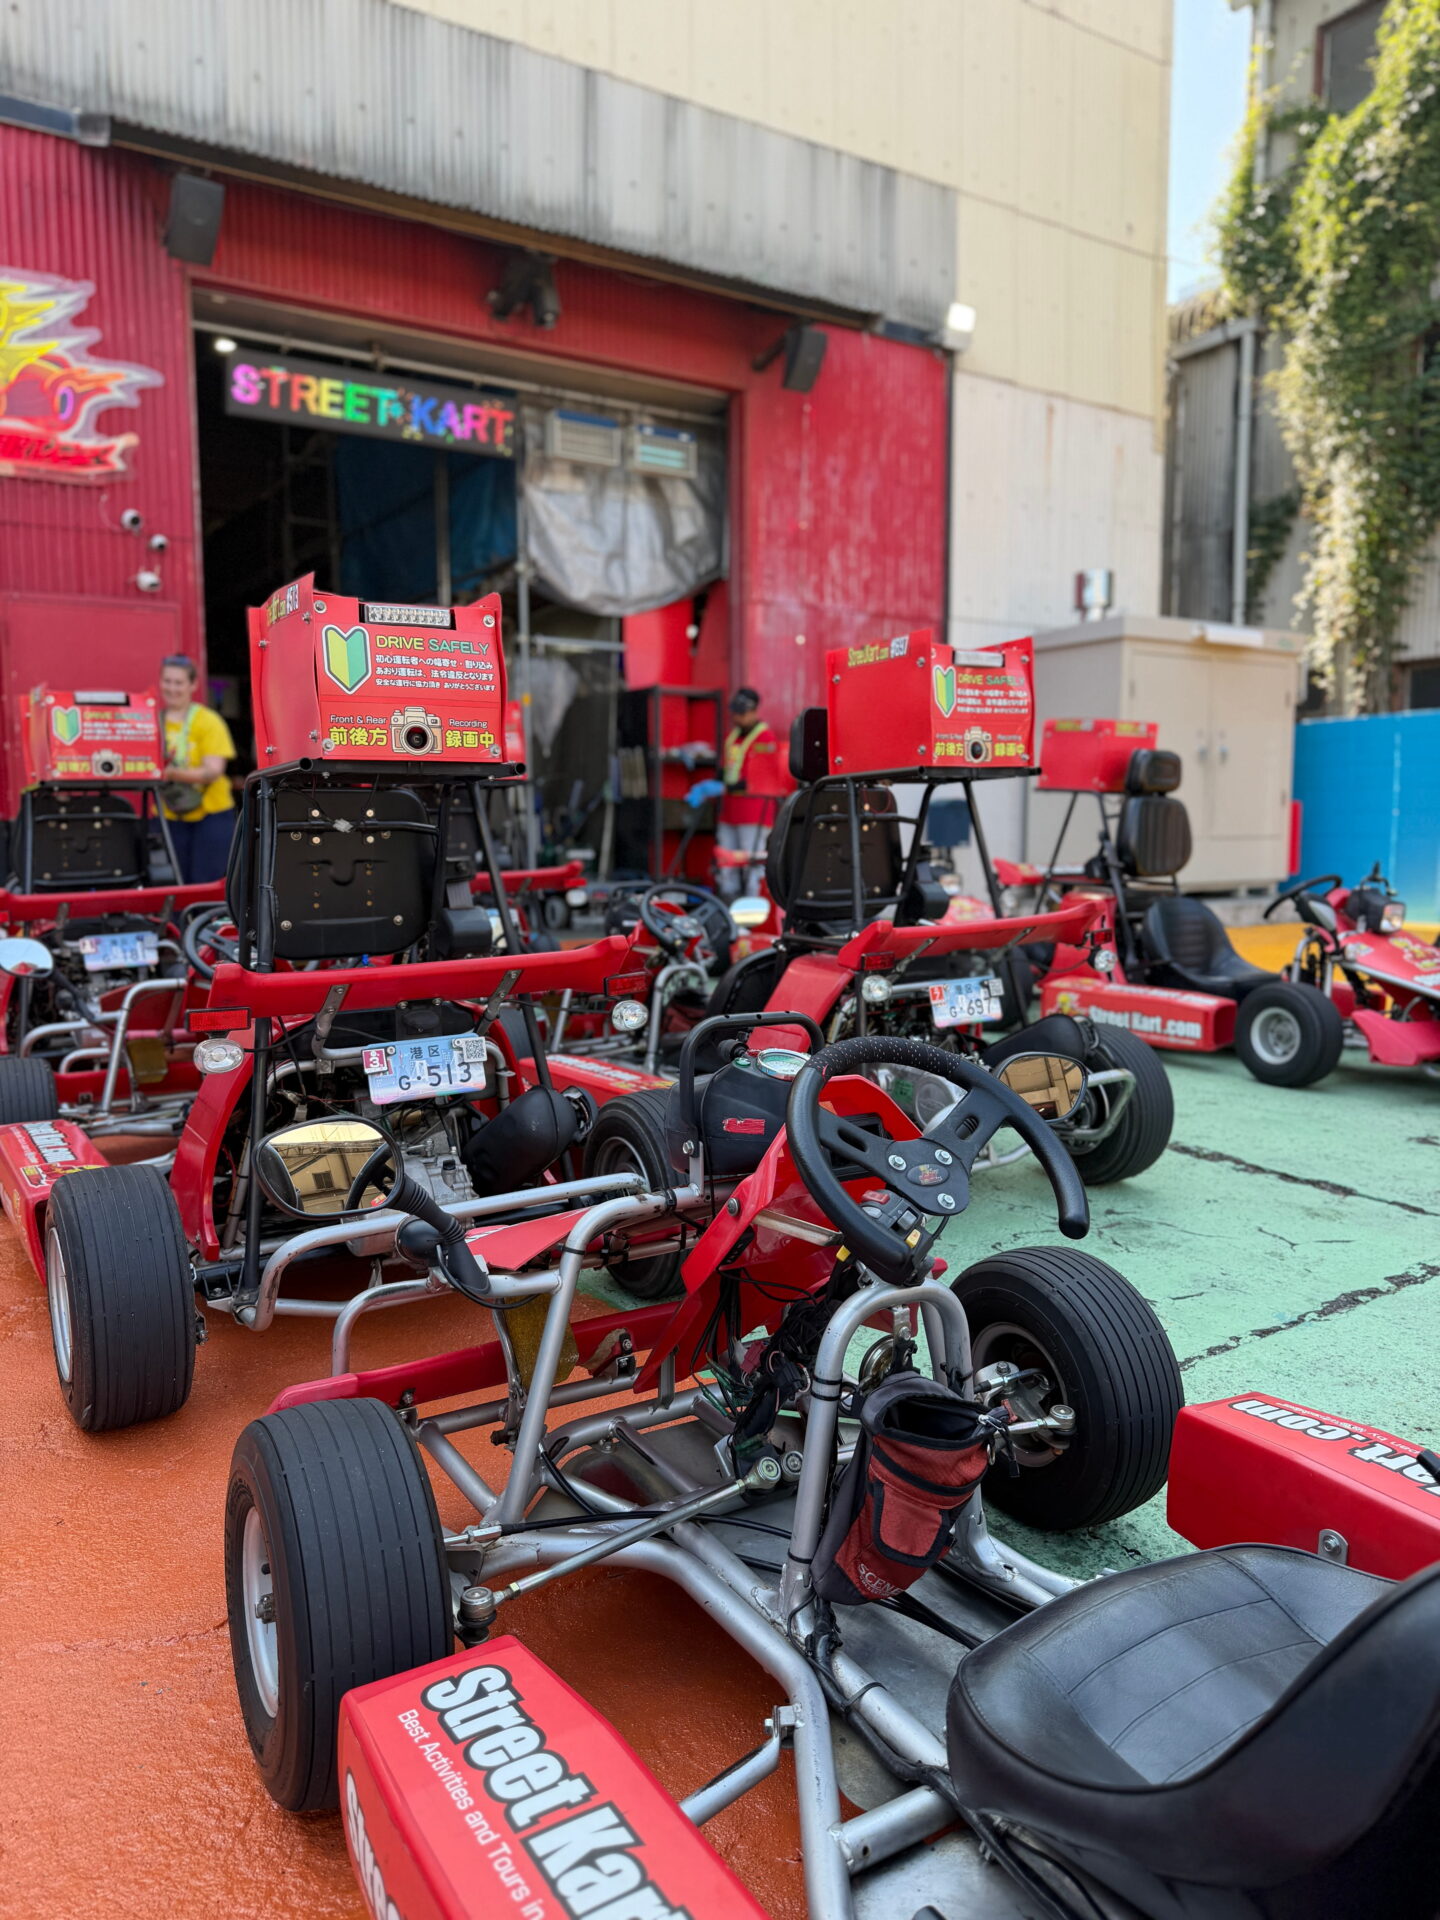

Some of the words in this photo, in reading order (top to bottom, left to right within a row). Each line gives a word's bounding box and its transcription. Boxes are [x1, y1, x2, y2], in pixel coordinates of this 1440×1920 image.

[231, 363, 398, 426] STREET
[411, 395, 514, 445] KART
[376, 635, 425, 650] DRIVE
[428, 639, 490, 655] SAFELY
[330, 714, 354, 724] Front
[356, 716, 364, 724] &
[365, 716, 387, 725] Rear
[449, 718, 488, 729] Recording
[329, 726, 388, 747] 前後方
[445, 730, 495, 749] 録画中
[423, 1665, 598, 1832] Street
[397, 1708, 431, 1743] Best
[419, 1739, 475, 1811] Activities
[464, 1810, 500, 1847] and
[485, 1841, 532, 1902] Tours
[519, 1898, 546, 1920] in
